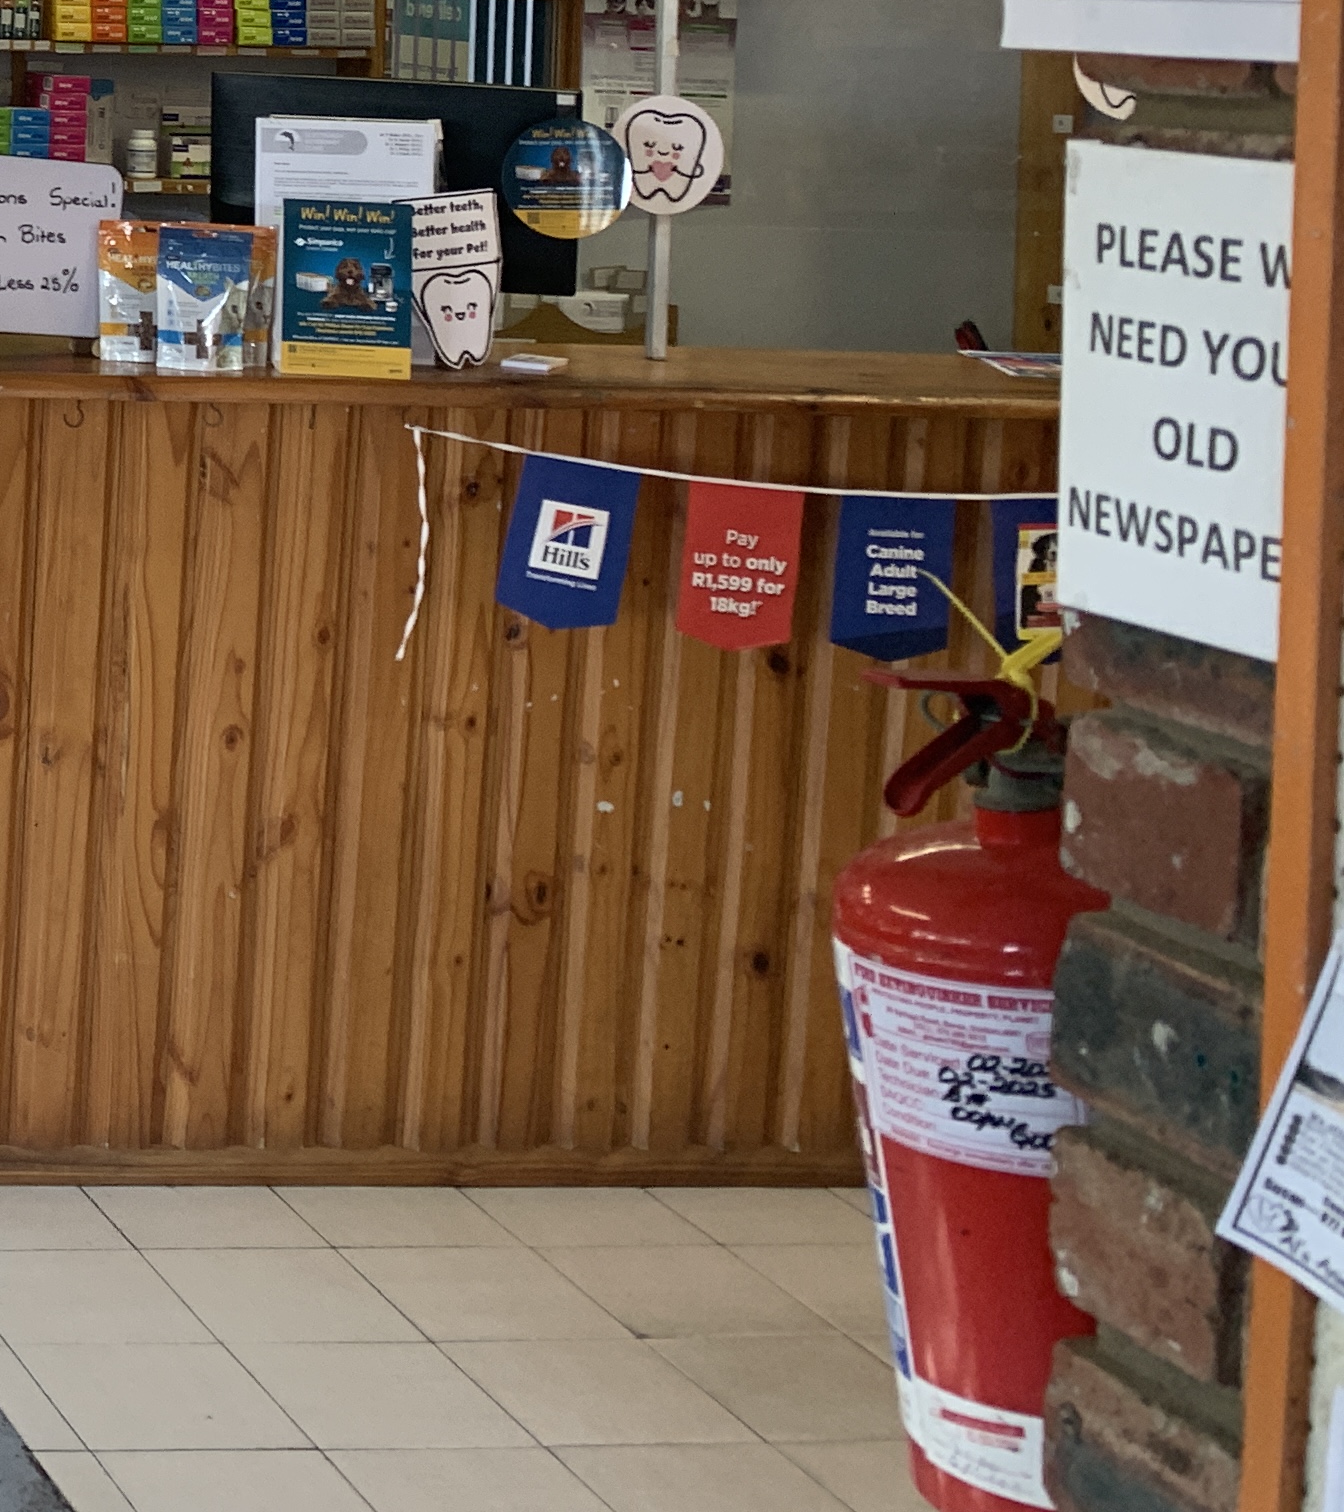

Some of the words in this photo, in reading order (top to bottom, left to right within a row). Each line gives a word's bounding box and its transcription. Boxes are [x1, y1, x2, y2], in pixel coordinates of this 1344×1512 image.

[50, 182, 117, 211] Special!
[18, 224, 66, 244] Bites
[1095, 222, 1244, 284] PLEASE
[1089, 312, 1188, 368] NEED
[1152, 416, 1239, 473] OLD
[726, 529, 759, 551] Pay
[541, 545, 590, 572] Hill's
[693, 552, 715, 569] up
[722, 553, 741, 568] to
[746, 557, 787, 575] only
[866, 544, 925, 561] Canine
[869, 563, 918, 579] Adult
[692, 573, 753, 593] R1,599
[756, 577, 786, 596] for
[867, 581, 918, 600] Large
[865, 599, 918, 617] Breed
